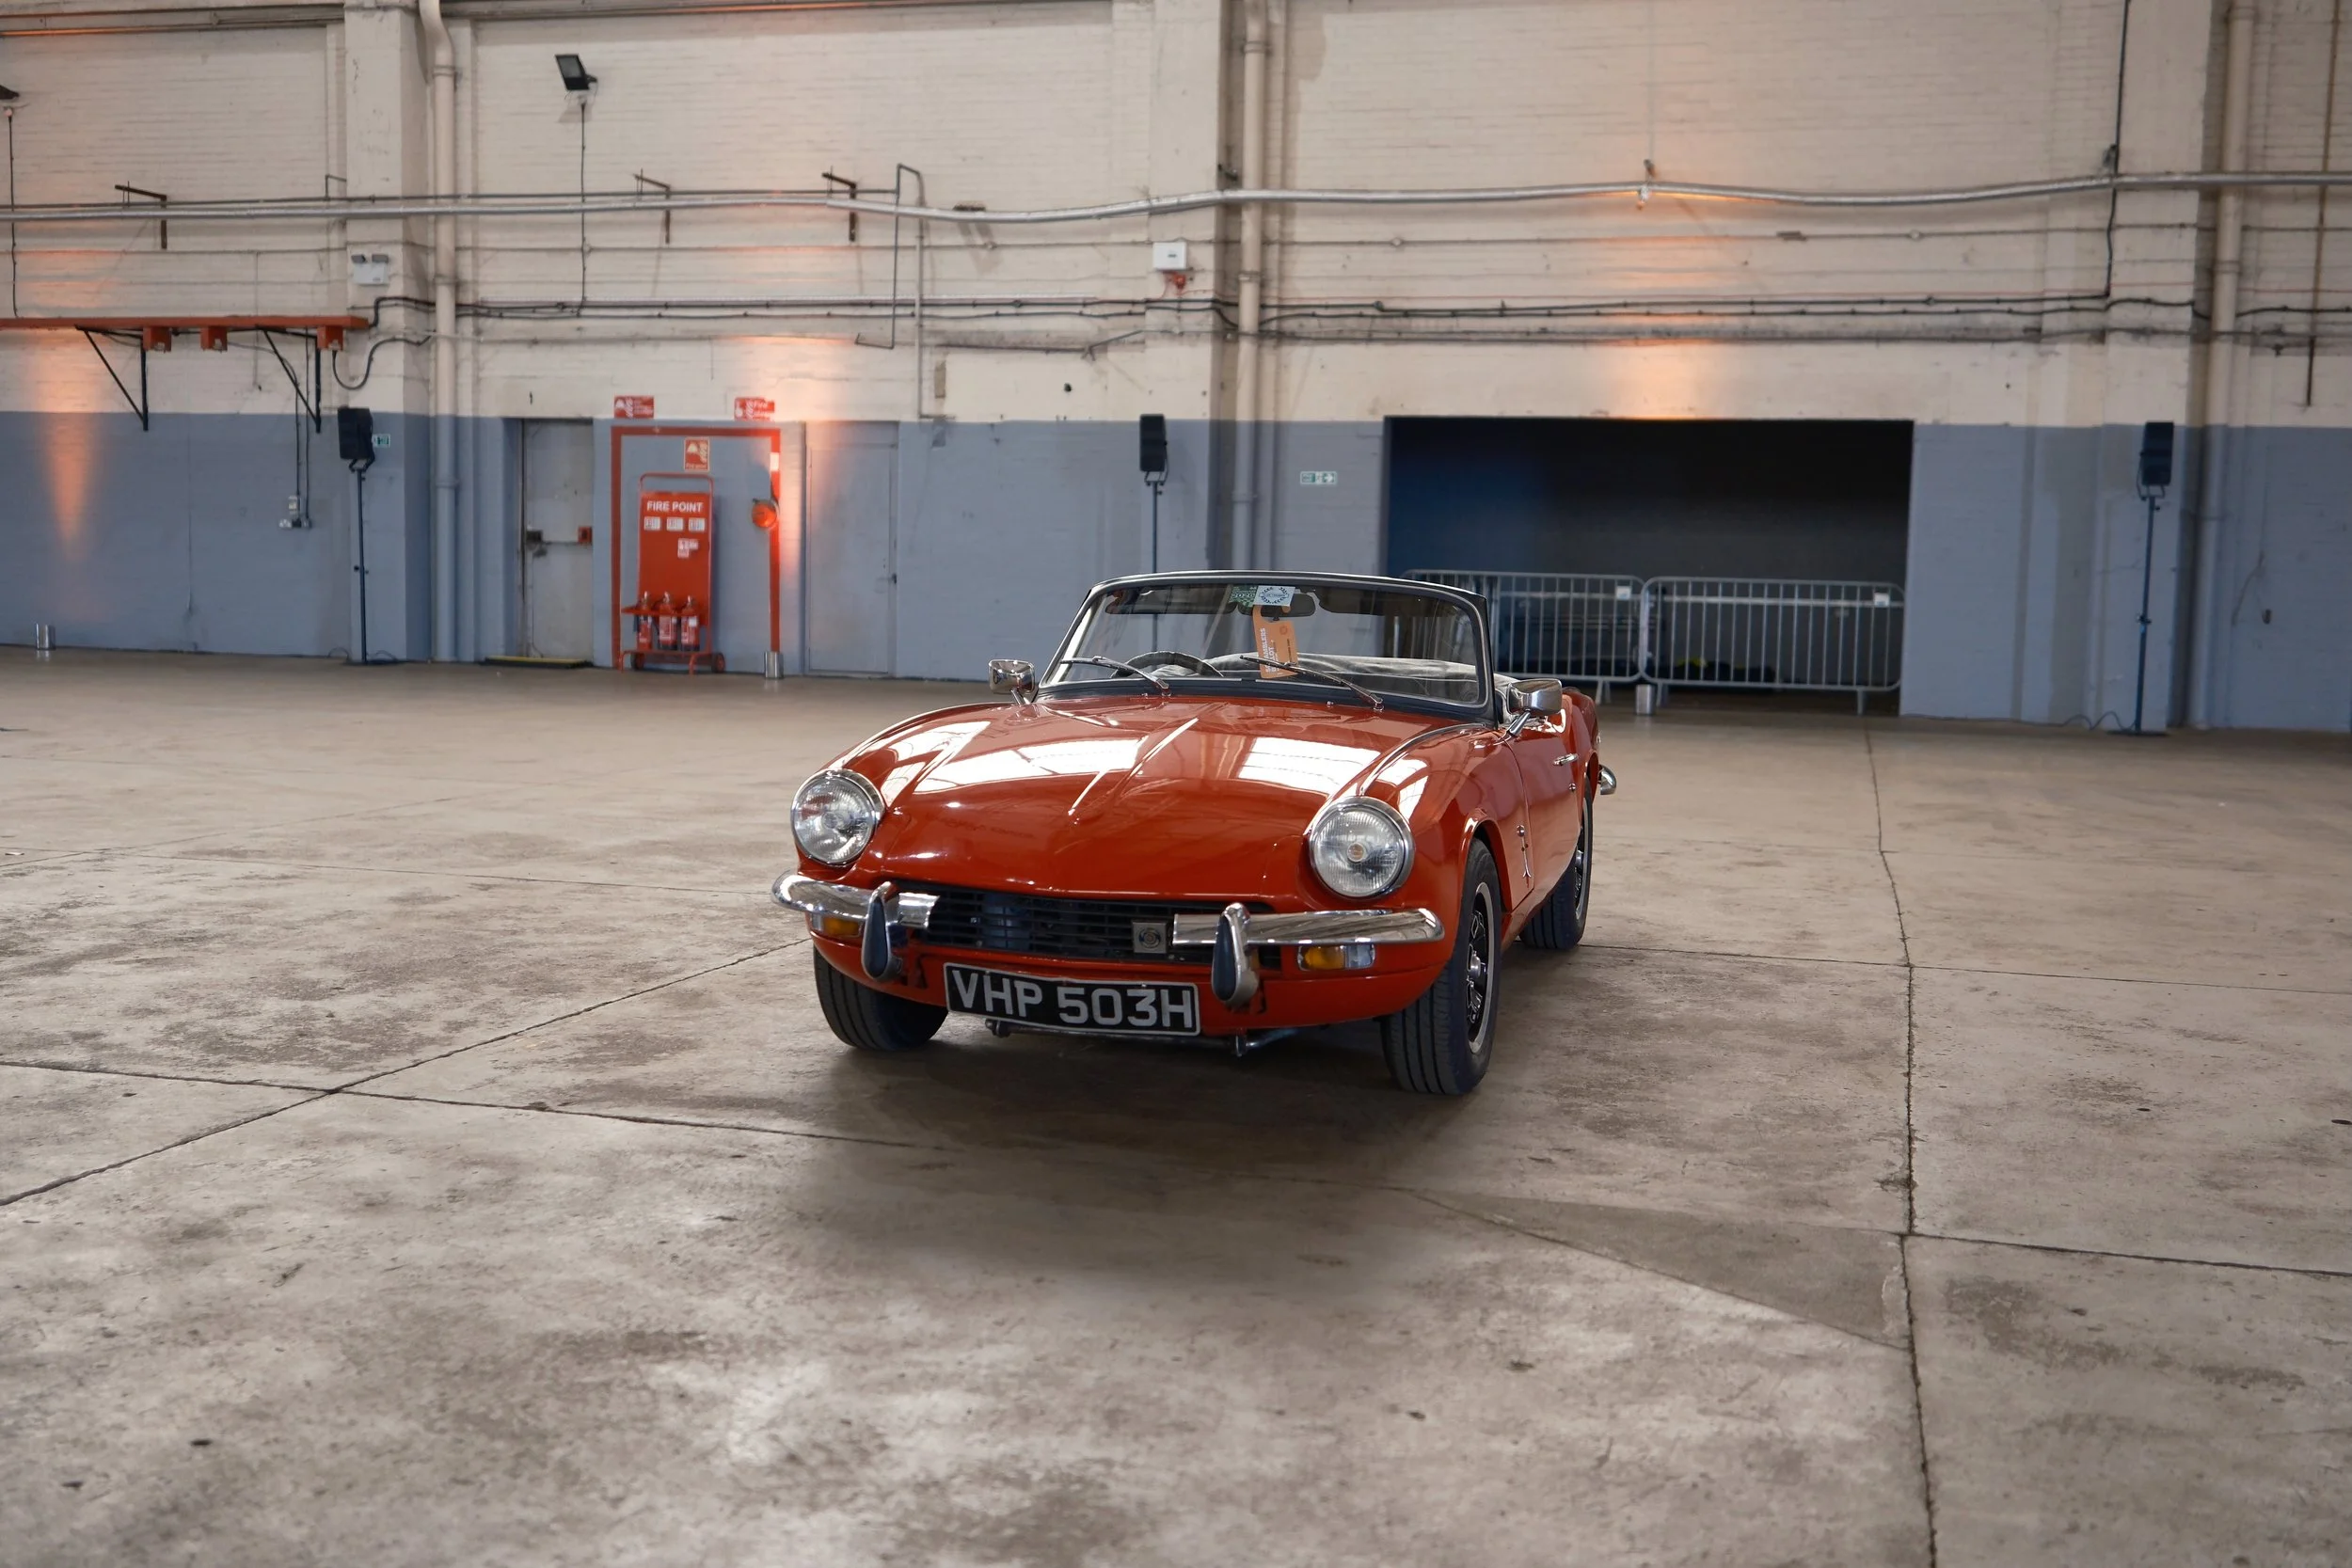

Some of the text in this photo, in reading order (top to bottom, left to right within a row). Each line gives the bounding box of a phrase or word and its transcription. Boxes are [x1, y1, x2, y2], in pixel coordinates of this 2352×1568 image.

[646, 500, 704, 513] FIRE POINT
[952, 970, 1193, 1029] VHP 503H
